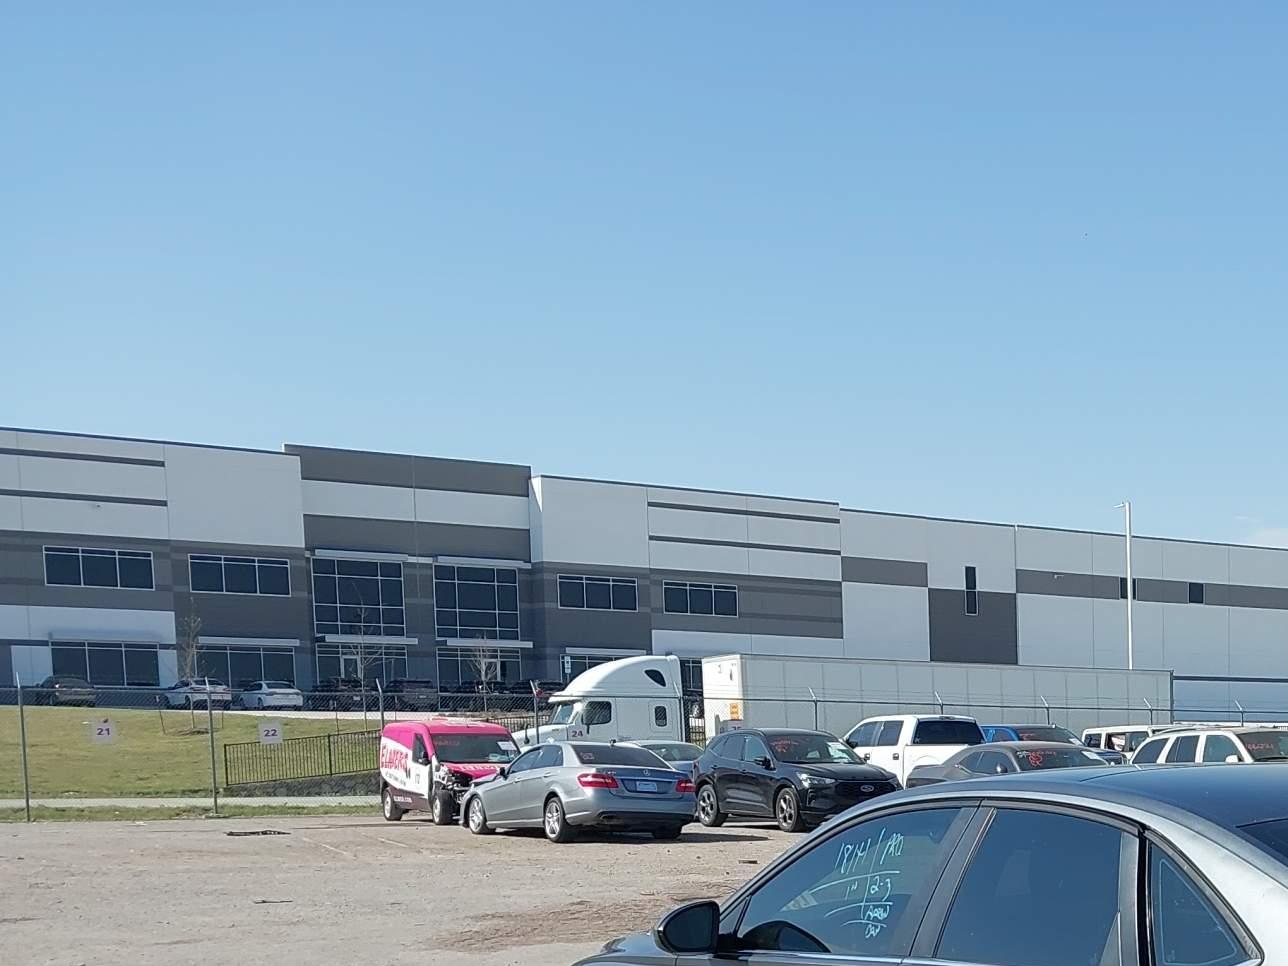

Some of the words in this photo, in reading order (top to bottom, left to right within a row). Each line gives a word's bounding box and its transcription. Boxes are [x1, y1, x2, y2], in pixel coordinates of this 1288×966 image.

[96, 727, 111, 736] 21
[263, 728, 277, 737] 22
[571, 730, 583, 738] 24
